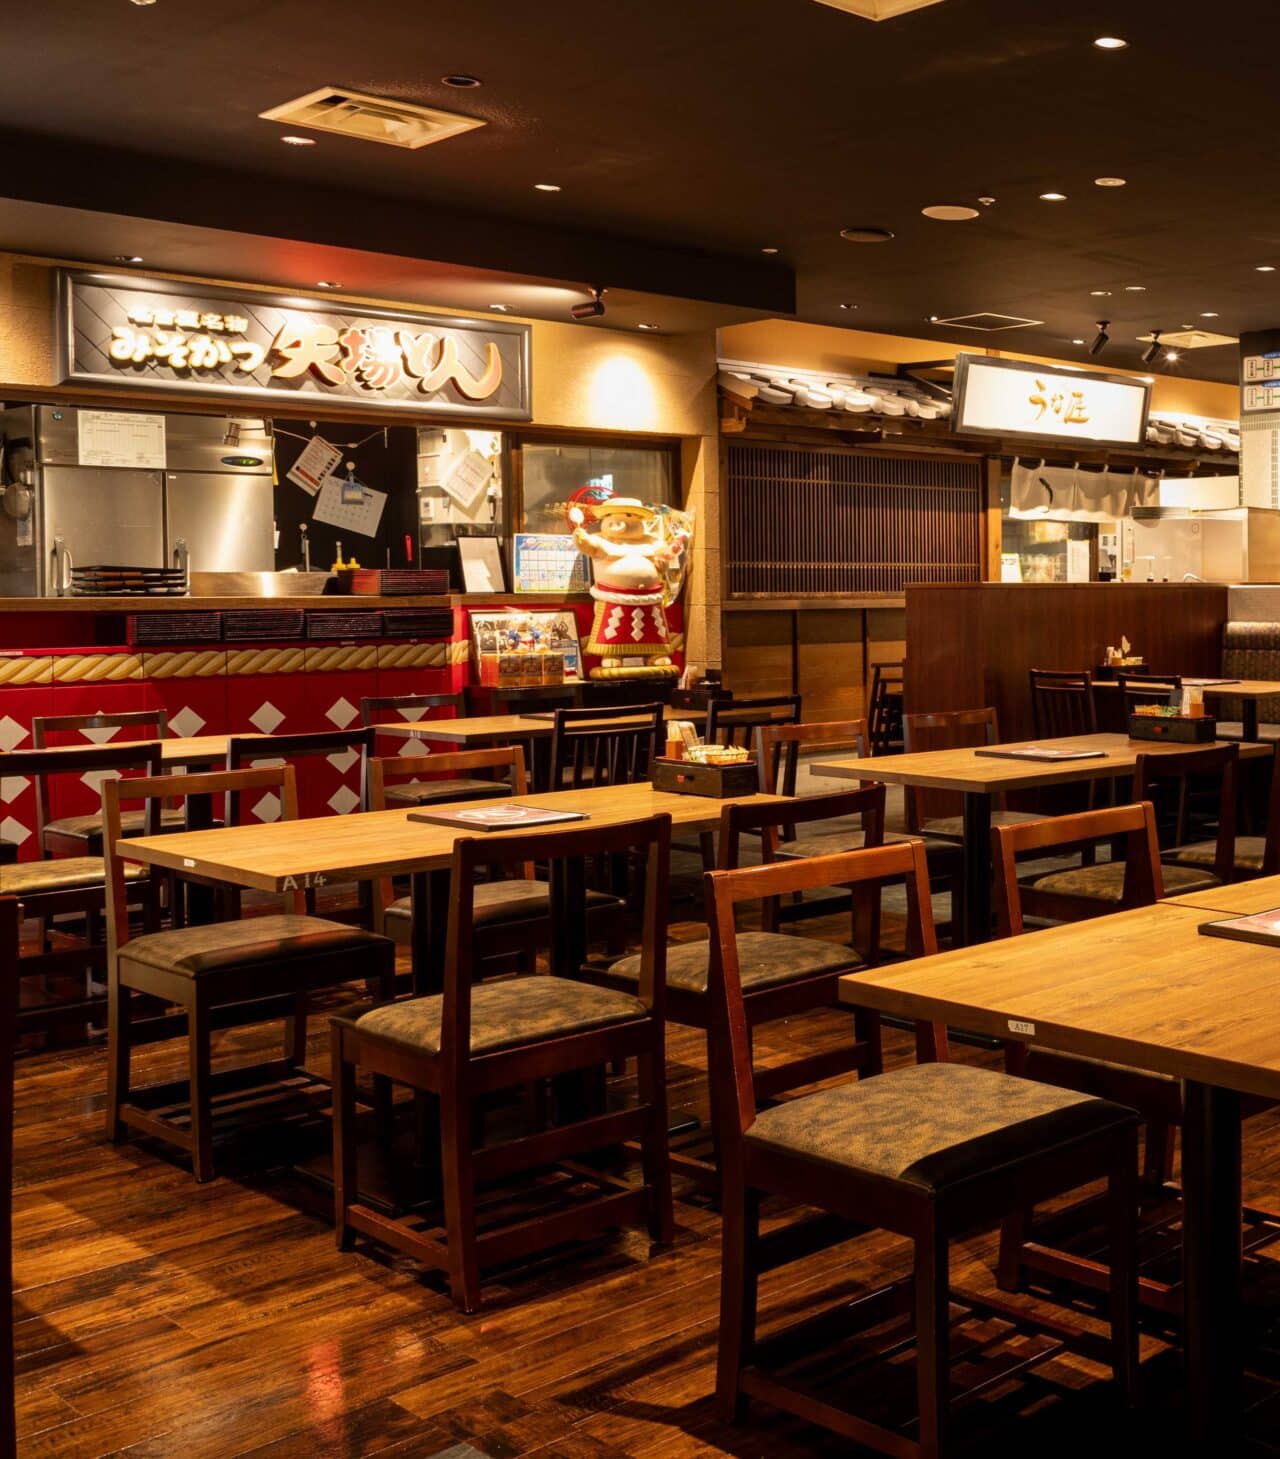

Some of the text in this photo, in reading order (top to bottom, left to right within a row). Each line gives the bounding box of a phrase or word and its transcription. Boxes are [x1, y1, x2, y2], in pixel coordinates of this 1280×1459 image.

[109, 326, 265, 373] みそかつ
[271, 312, 503, 401] 矢場とん
[282, 872, 327, 891] A14
